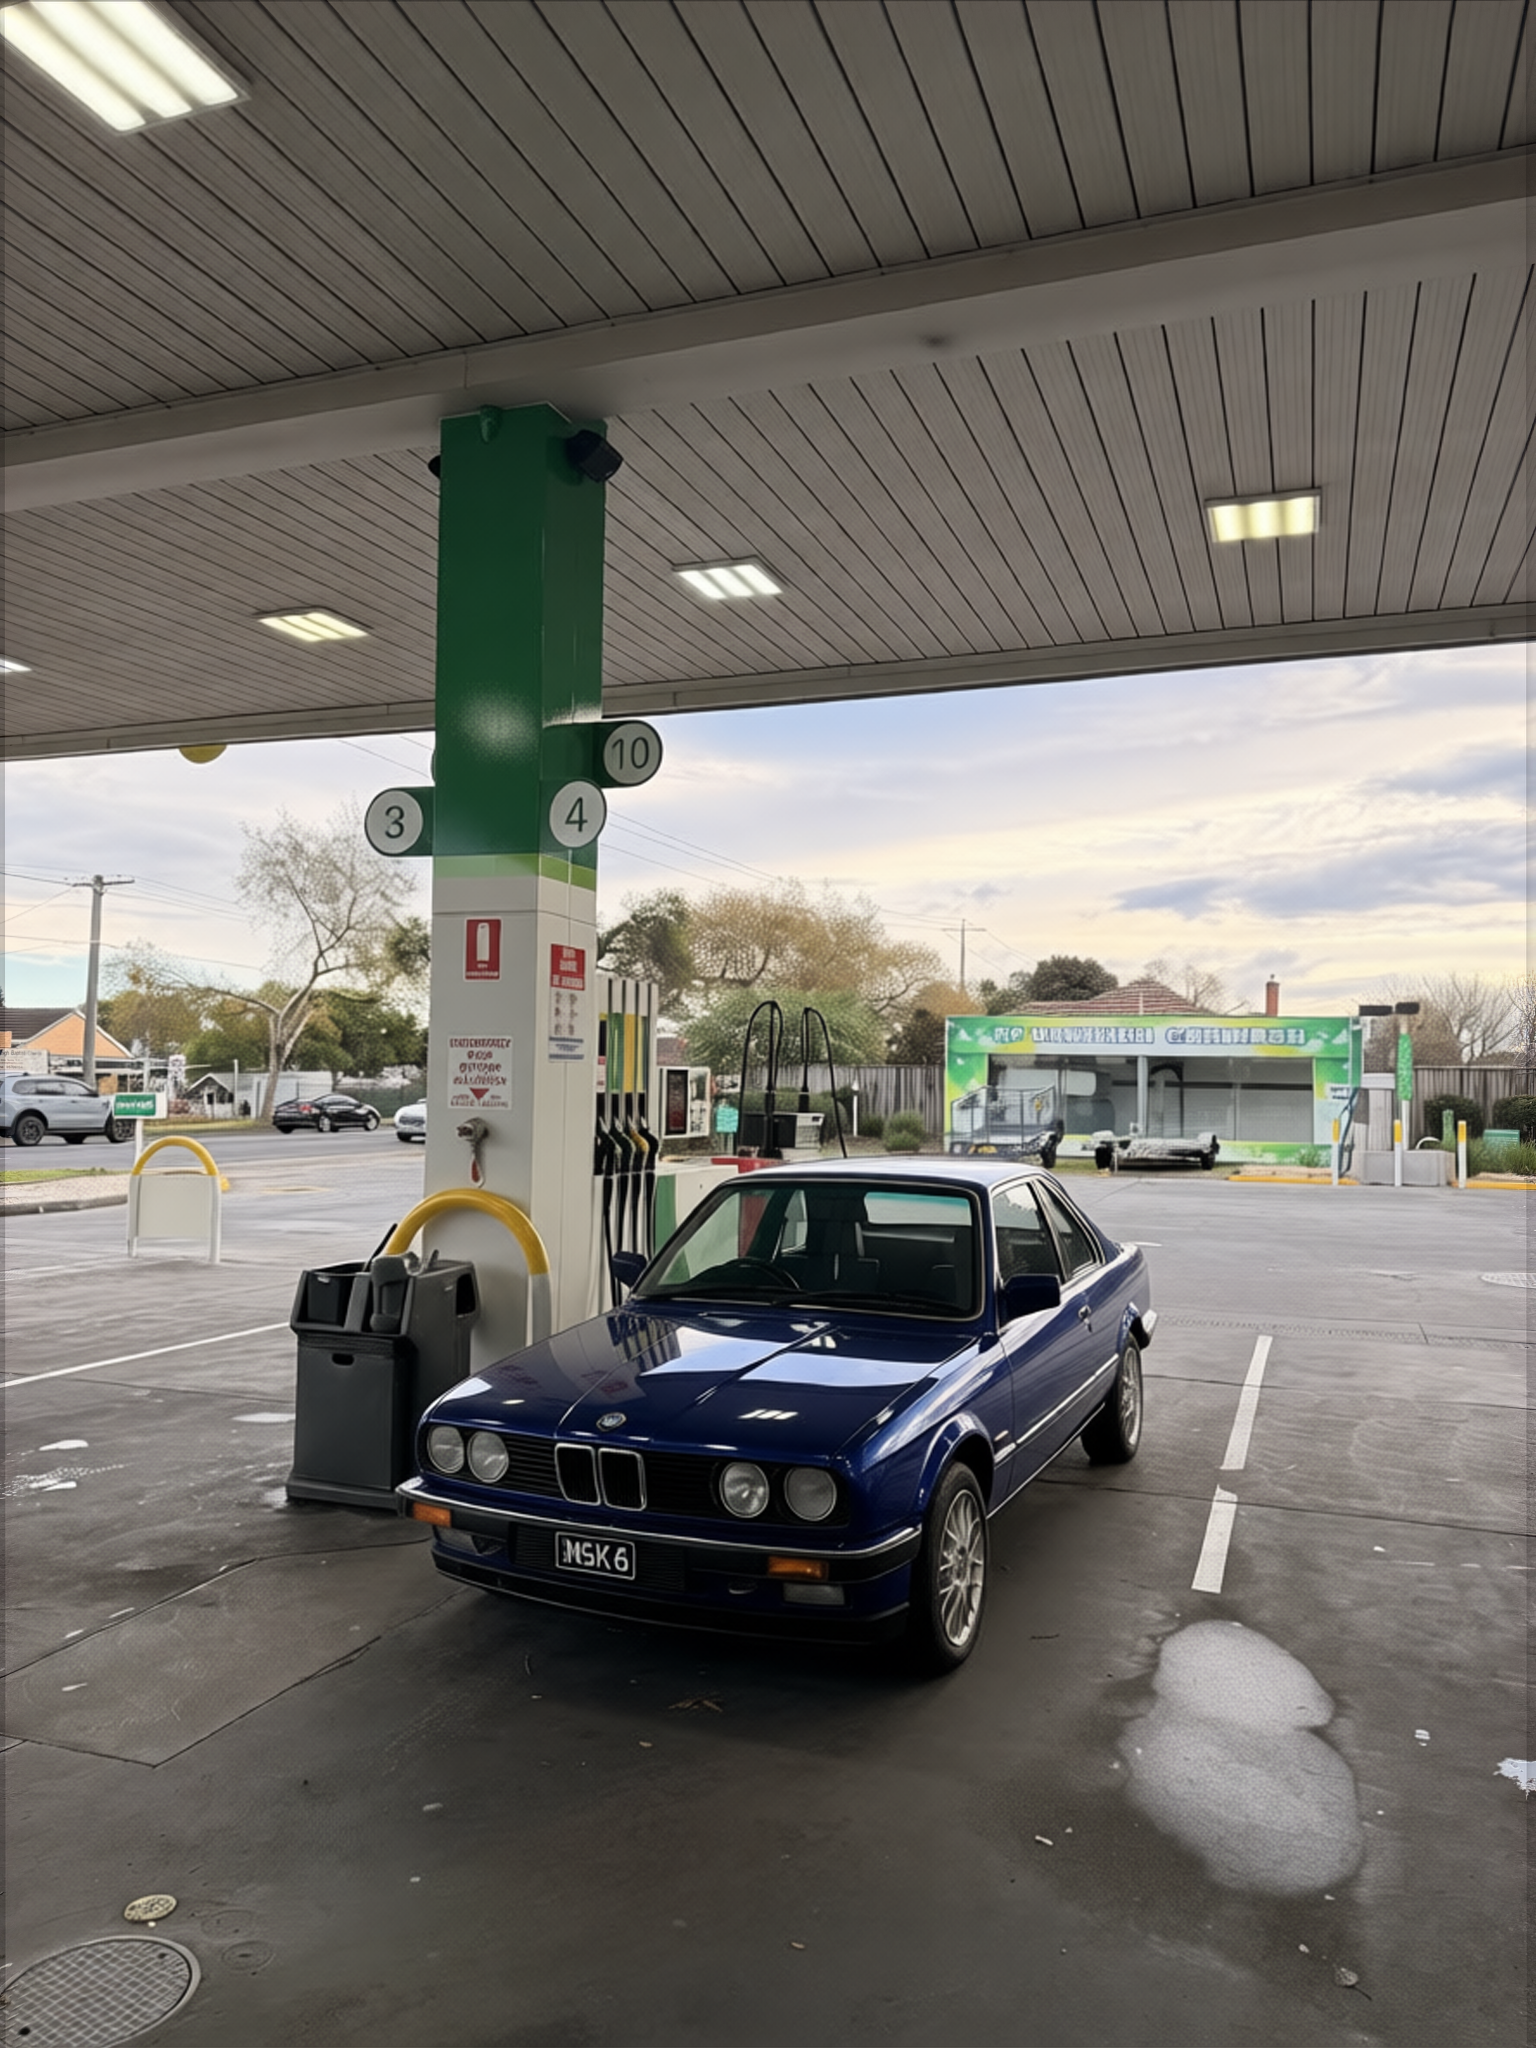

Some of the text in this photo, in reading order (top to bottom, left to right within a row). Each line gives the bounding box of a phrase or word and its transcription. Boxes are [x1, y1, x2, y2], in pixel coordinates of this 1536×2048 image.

[611, 736, 650, 771] 10
[384, 805, 406, 840] 3
[564, 796, 589, 833] 4
